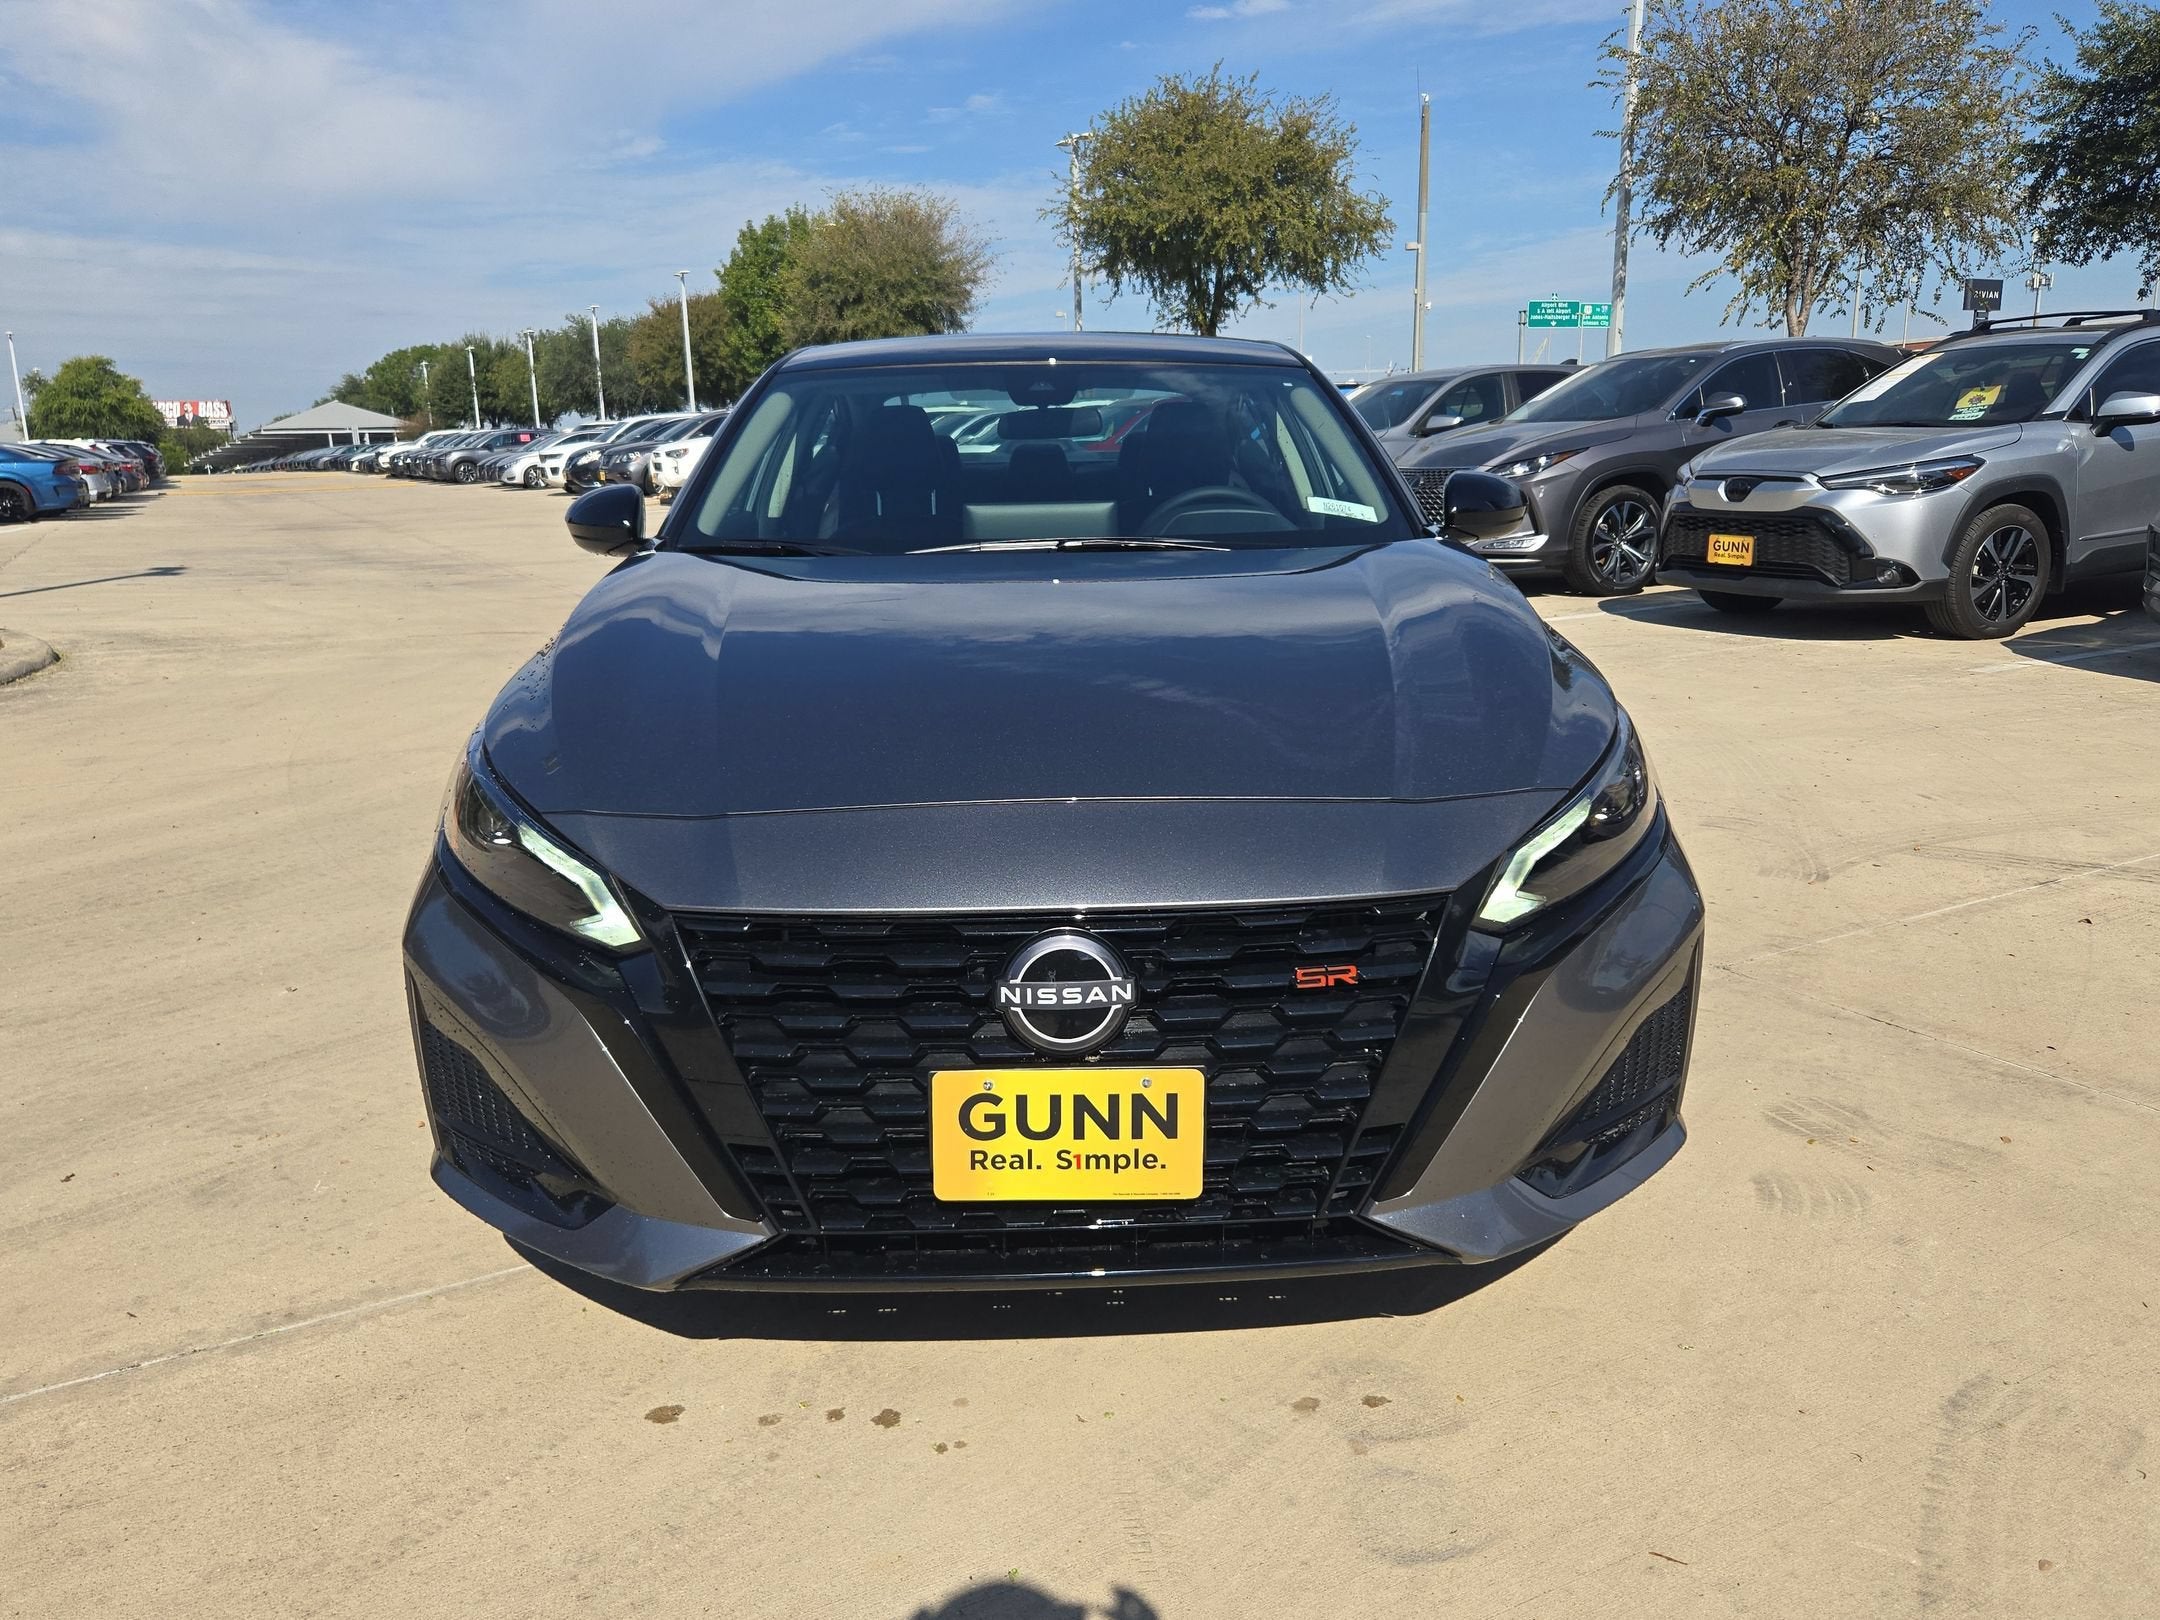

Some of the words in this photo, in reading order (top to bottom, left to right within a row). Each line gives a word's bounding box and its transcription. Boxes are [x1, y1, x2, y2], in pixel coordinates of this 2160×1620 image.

[1713, 540, 1750, 553] GUNN
[1296, 964, 1358, 989] SR
[1000, 983, 1132, 1005] NISSAN
[958, 1092, 1179, 1141] GUNN
[970, 1148, 1042, 1171] Real.
